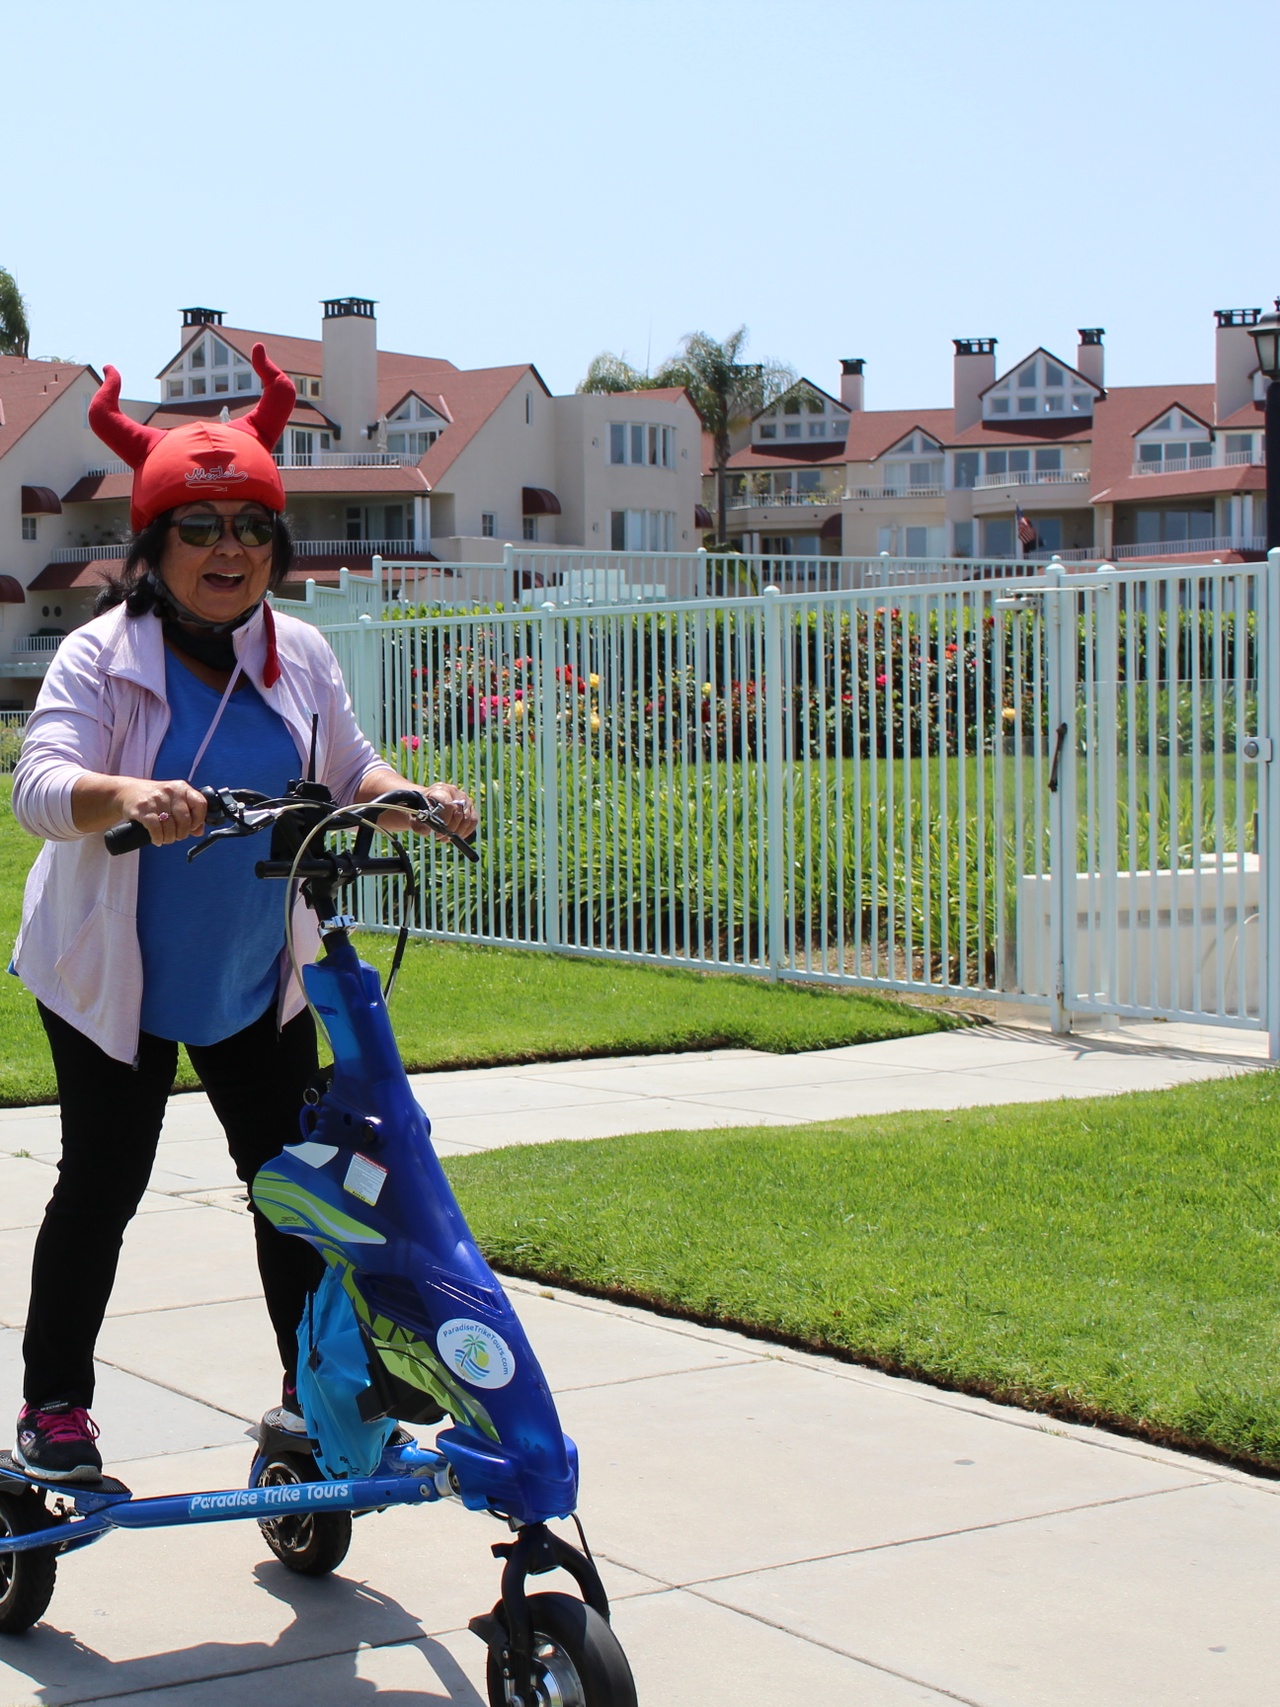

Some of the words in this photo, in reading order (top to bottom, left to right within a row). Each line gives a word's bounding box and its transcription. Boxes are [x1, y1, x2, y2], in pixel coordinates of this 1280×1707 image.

[442, 1323, 509, 1375] ParadiseTrikeTours.com
[191, 1491, 258, 1510] Paradise
[264, 1487, 301, 1504] Trike
[307, 1483, 349, 1500] Tours
